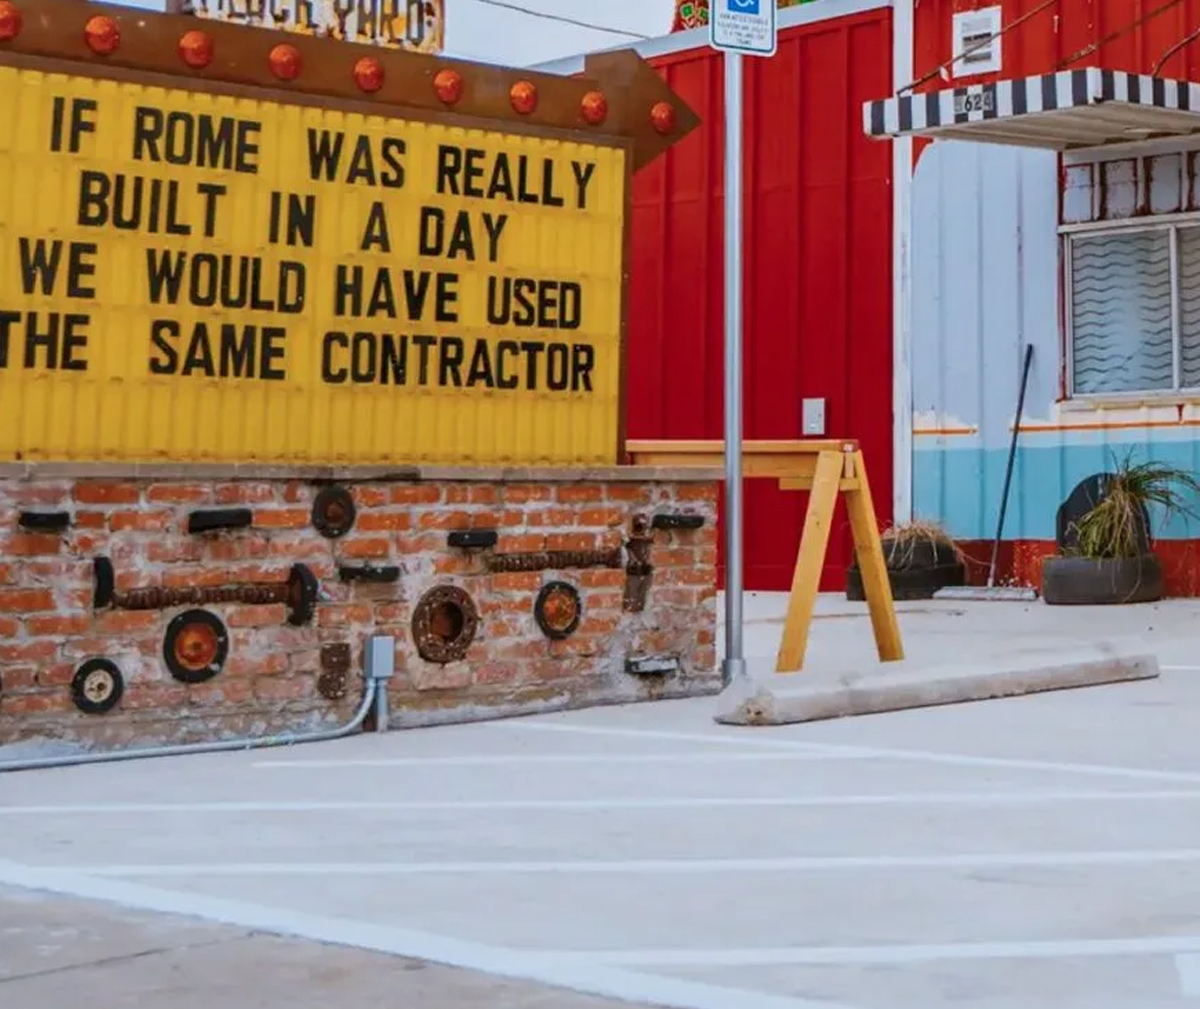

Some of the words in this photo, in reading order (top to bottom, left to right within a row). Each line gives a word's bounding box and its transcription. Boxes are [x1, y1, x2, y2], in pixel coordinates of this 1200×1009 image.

[50, 96, 97, 153] IF
[132, 106, 262, 174] ROME
[307, 128, 406, 188] WAS
[436, 144, 596, 209] REALLY
[77, 170, 227, 238] BUILT
[268, 191, 316, 247] IN
[360, 201, 391, 253] A
[418, 205, 508, 262] DAY
[18, 237, 98, 299] WE
[146, 248, 306, 314] WOULD
[334, 264, 460, 323] HAVE
[487, 275, 582, 330] USED
[0, 310, 90, 371] THE
[149, 319, 286, 380] SAME
[321, 331, 595, 392] CONTRACTOR
